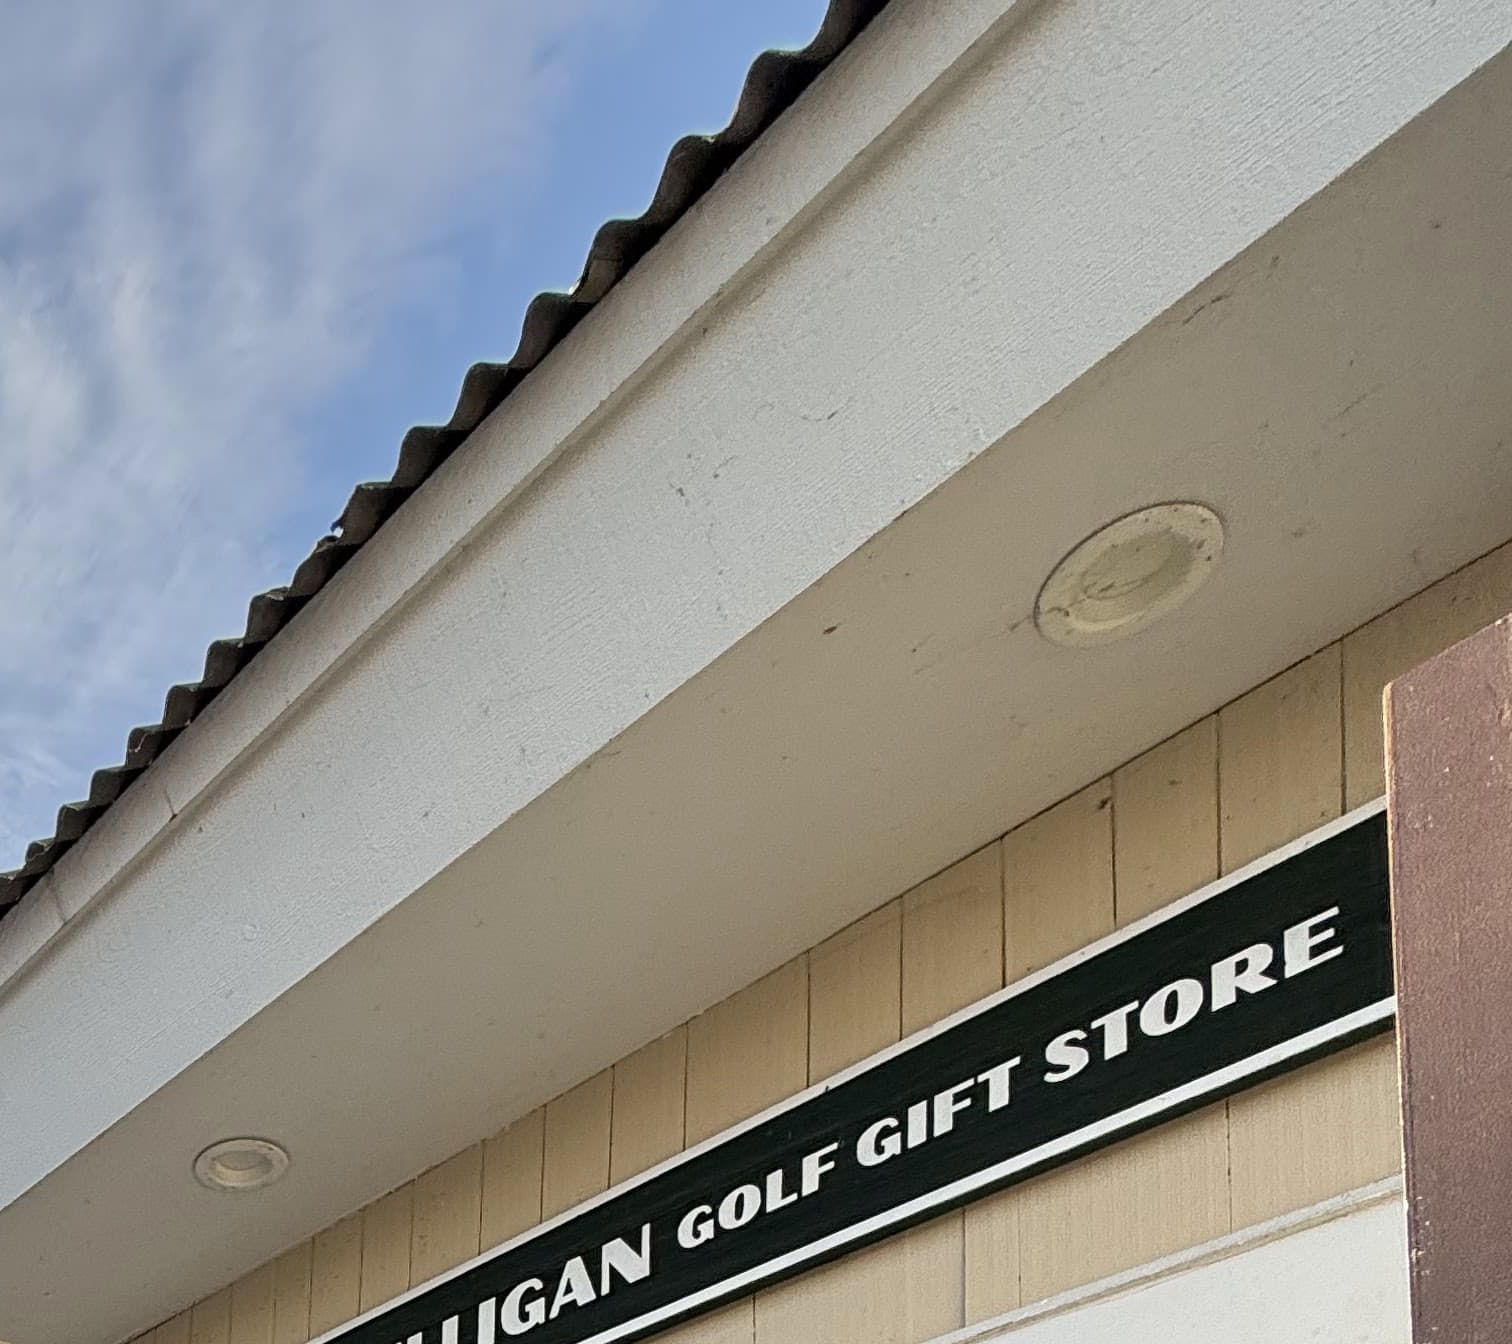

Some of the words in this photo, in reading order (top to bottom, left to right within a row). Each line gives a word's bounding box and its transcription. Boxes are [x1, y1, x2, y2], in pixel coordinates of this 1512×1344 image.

[677, 1142, 837, 1249] GOLF
[855, 1055, 1021, 1167] GIFT
[1043, 905, 1345, 1084] STORE
